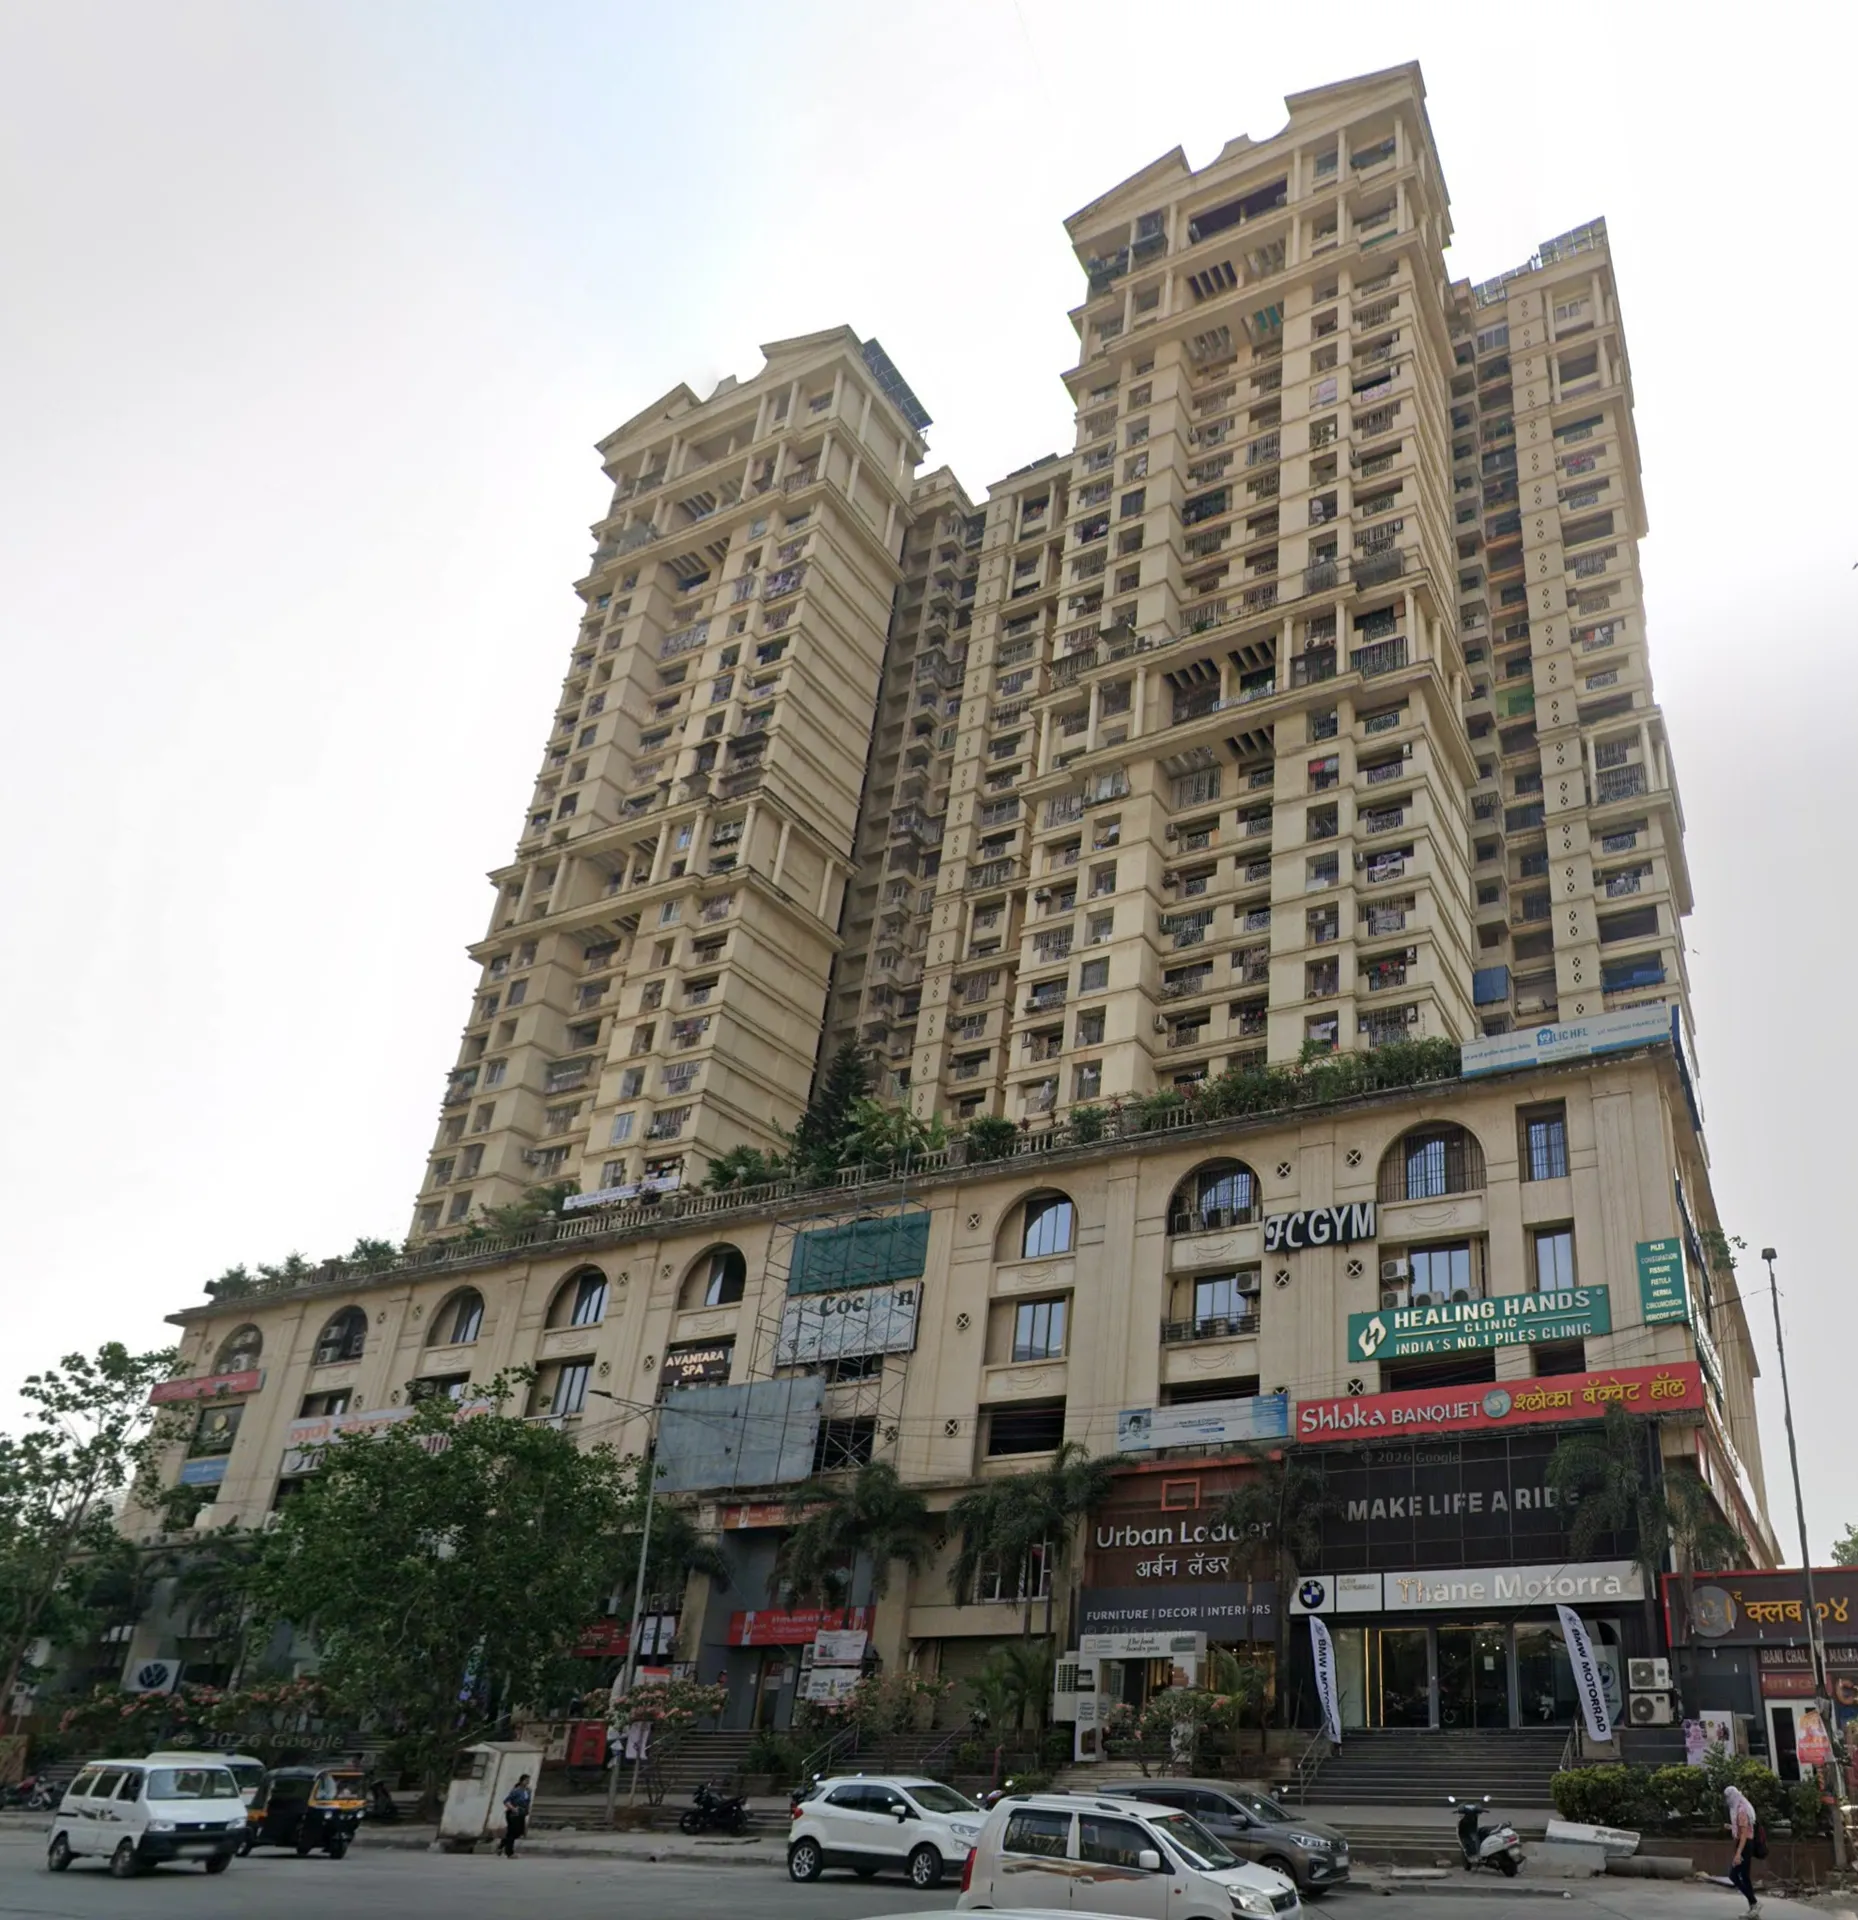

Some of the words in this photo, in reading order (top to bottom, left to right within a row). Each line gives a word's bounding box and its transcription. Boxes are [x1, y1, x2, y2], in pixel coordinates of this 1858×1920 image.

[1553, 1028, 1570, 1042] LIC
[1570, 1026, 1589, 1041] HFL
[1308, 1202, 1376, 1245] GYM
[1650, 1243, 1665, 1252] PILES
[1649, 1265, 1671, 1275] FISSURE
[1651, 1276, 1672, 1286] FISTULA
[1652, 1288, 1672, 1297] HERNIA
[1395, 1301, 1495, 1329] HEALING
[1504, 1290, 1590, 1316] HANDS
[1464, 1318, 1517, 1333] CLINIC
[1396, 1338, 1452, 1355] INDIA'S
[1495, 1328, 1537, 1344] PILES
[1542, 1323, 1592, 1339] CLINIC
[665, 1350, 724, 1367] AVANTARA
[682, 1364, 704, 1376] SPA
[1513, 1383, 1574, 1411] श्लोका
[1650, 1371, 1687, 1399] हॉल
[1301, 1402, 1386, 1433] Shloka
[1392, 1401, 1481, 1425] BANQUET
[1347, 1495, 1423, 1521] MAKE
[1429, 1491, 1483, 1516] LIFE
[1491, 1490, 1508, 1513] A
[1097, 1525, 1172, 1548] Urban
[1136, 1553, 1178, 1577] अर्बन
[1396, 1577, 1486, 1604] Thane
[1086, 1608, 1149, 1621] FURNITURE
[1158, 1606, 1197, 1618] DECOR
[1744, 1600, 1803, 1624] क्लब
[1318, 1638, 1328, 1668] BMW
[1571, 1627, 1588, 1658] BMW
[1761, 1649, 1784, 1664] IRANI
[1581, 1660, 1607, 1733] MOTORRAD
